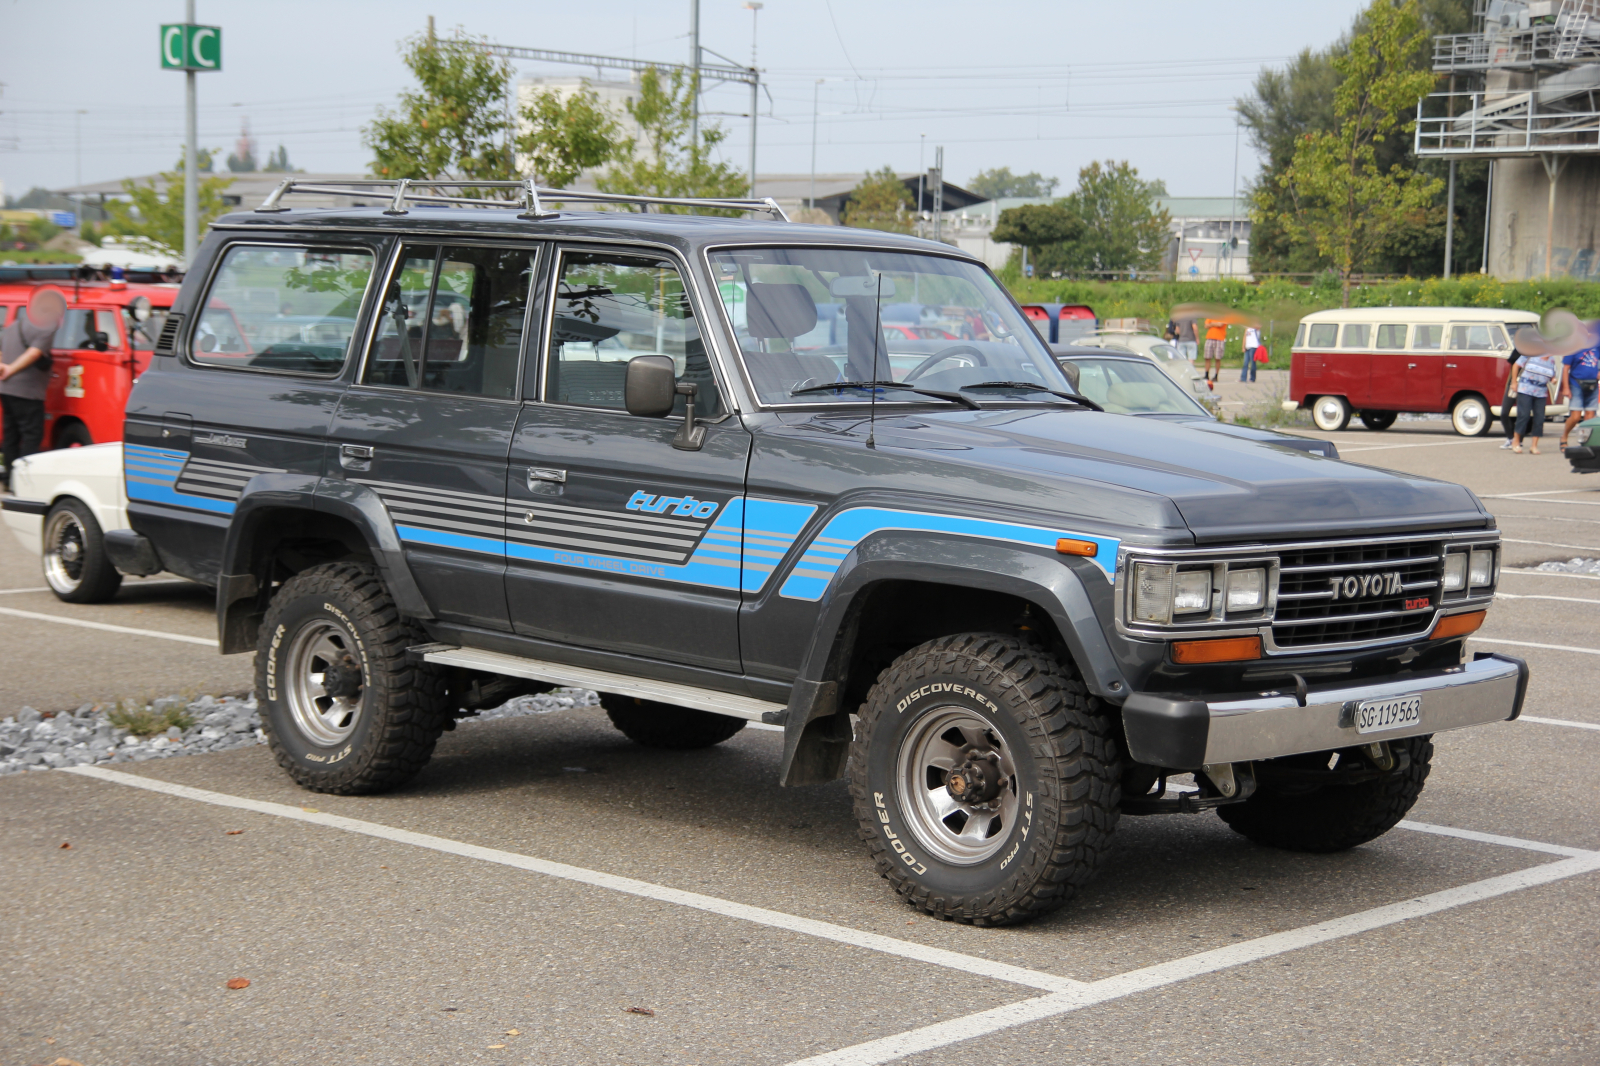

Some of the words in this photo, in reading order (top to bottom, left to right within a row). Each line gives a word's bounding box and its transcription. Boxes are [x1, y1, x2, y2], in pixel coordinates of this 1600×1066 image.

[164, 26, 181, 66] C
[191, 28, 216, 67] C
[625, 489, 719, 519] turbo
[554, 553, 584, 565] FOUR
[588, 557, 627, 571] WHEEL
[630, 563, 666, 576] DRIVE
[1329, 572, 1402, 600] TOYOTA
[1405, 597, 1429, 610] turbo
[323, 602, 371, 687] DISCOVERER
[266, 623, 287, 702] COOPER
[896, 682, 998, 714] DISCOVERER
[873, 791, 928, 876] COOPER
[1021, 791, 1034, 842] STT
[1000, 841, 1020, 871] PRO
